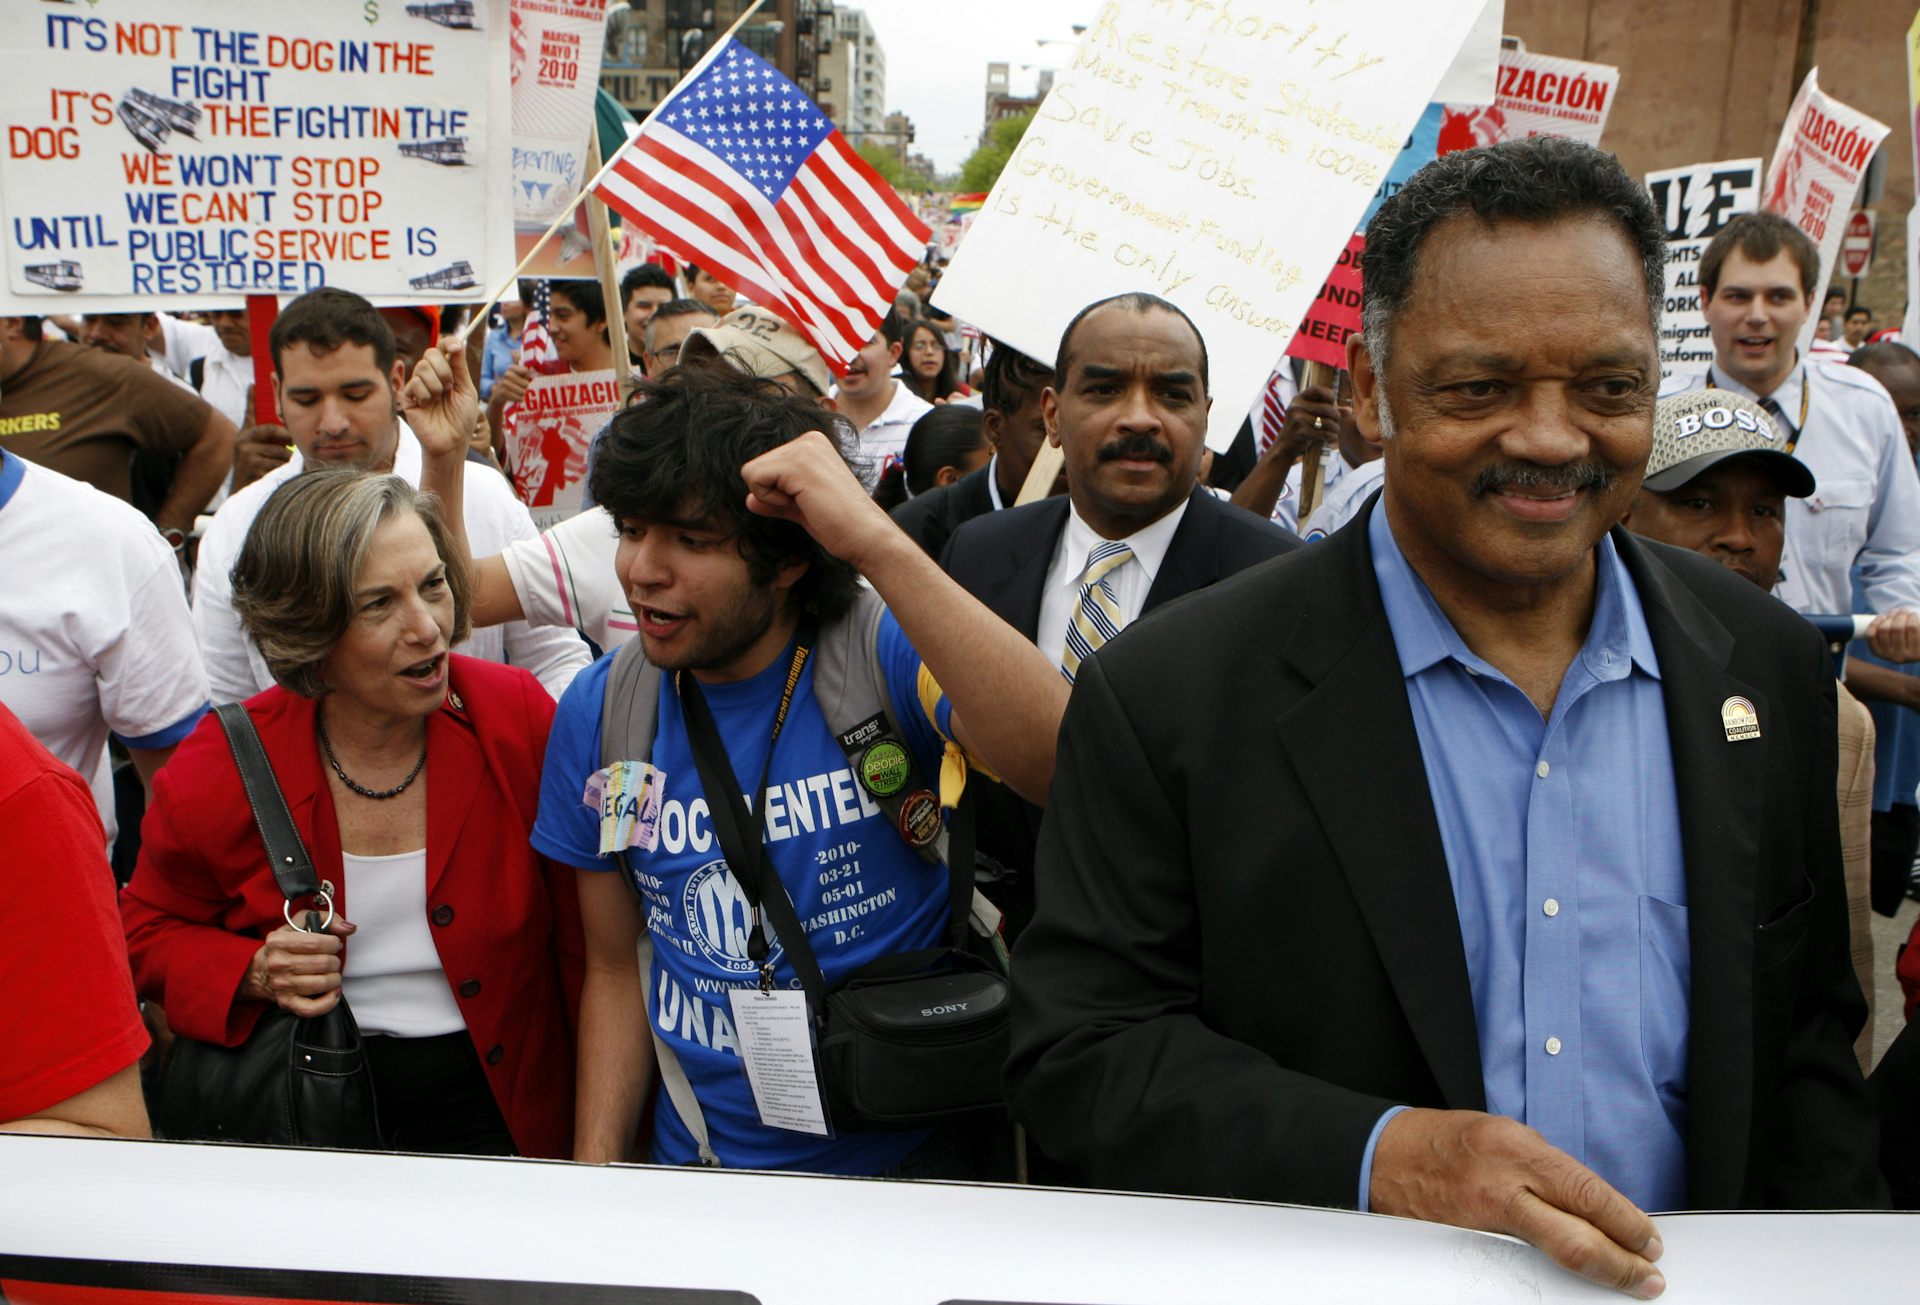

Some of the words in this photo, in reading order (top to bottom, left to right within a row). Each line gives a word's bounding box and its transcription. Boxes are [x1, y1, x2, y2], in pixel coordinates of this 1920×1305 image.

[46, 14, 108, 52] IT'S
[115, 22, 183, 59] NOT
[191, 27, 260, 65] THE
[267, 36, 334, 73] DOG
[339, 41, 369, 73] IN
[373, 42, 435, 75] THE
[541, 42, 572, 60] MAYO
[542, 30, 581, 45] MARCHA
[538, 58, 578, 81] 2010
[171, 66, 271, 102] FIGHT
[50, 88, 114, 126] IT'S
[203, 104, 271, 137] THE
[274, 106, 370, 138] FIGHT
[372, 109, 399, 138] IN
[1040, 82, 1158, 158] Save
[8, 126, 80, 160] DOG
[121, 153, 173, 185] WE
[178, 154, 282, 187] WON'T
[292, 156, 380, 188] STOP
[125, 192, 178, 224] WE
[182, 191, 276, 224] CAN'T
[293, 191, 382, 223] STOP
[13, 215, 119, 250] UNTIL
[128, 229, 249, 262] PUBLIC
[254, 229, 390, 260] SERVICE
[407, 227, 437, 257] IS
[1034, 202, 1101, 252] the
[1799, 208, 1827, 241] 2010
[132, 260, 326, 294] RESTORED
[1663, 296, 1703, 313] ORK
[1695, 400, 1722, 411] THE
[1674, 407, 1775, 442] BOSS
[865, 754, 905, 775] people
[880, 767, 900, 778] WALL
[873, 774, 903, 789] STREET
[686, 871, 706, 901] YOUTH
[819, 860, 861, 886] 03-21
[822, 880, 864, 906] 05-01
[834, 924, 865, 945] D.C.
[726, 960, 755, 971] 2009
[921, 1003, 967, 1017] SONY
